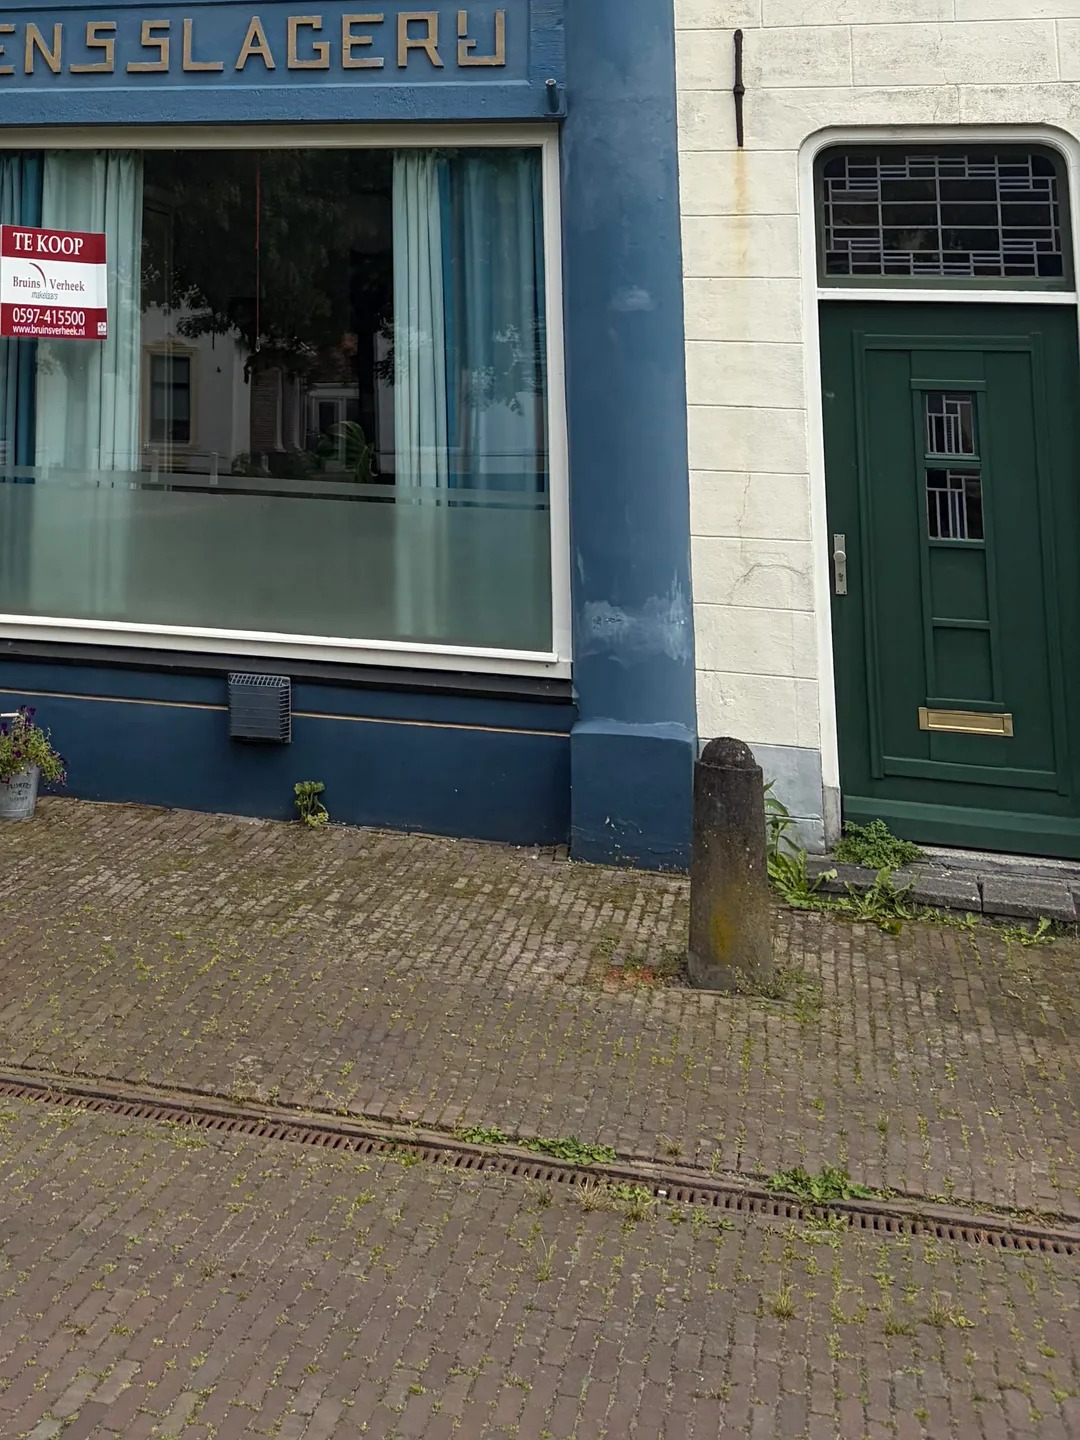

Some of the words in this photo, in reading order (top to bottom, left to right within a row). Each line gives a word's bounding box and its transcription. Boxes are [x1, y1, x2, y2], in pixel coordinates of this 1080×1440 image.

[13, 232, 33, 251] TE
[37, 235, 84, 255] KOOP
[13, 276, 41, 289] Bruins
[49, 279, 85, 292] Verheek
[13, 307, 85, 326] 0597-415500
[13, 324, 85, 336] www.bruinsverheek.nl
